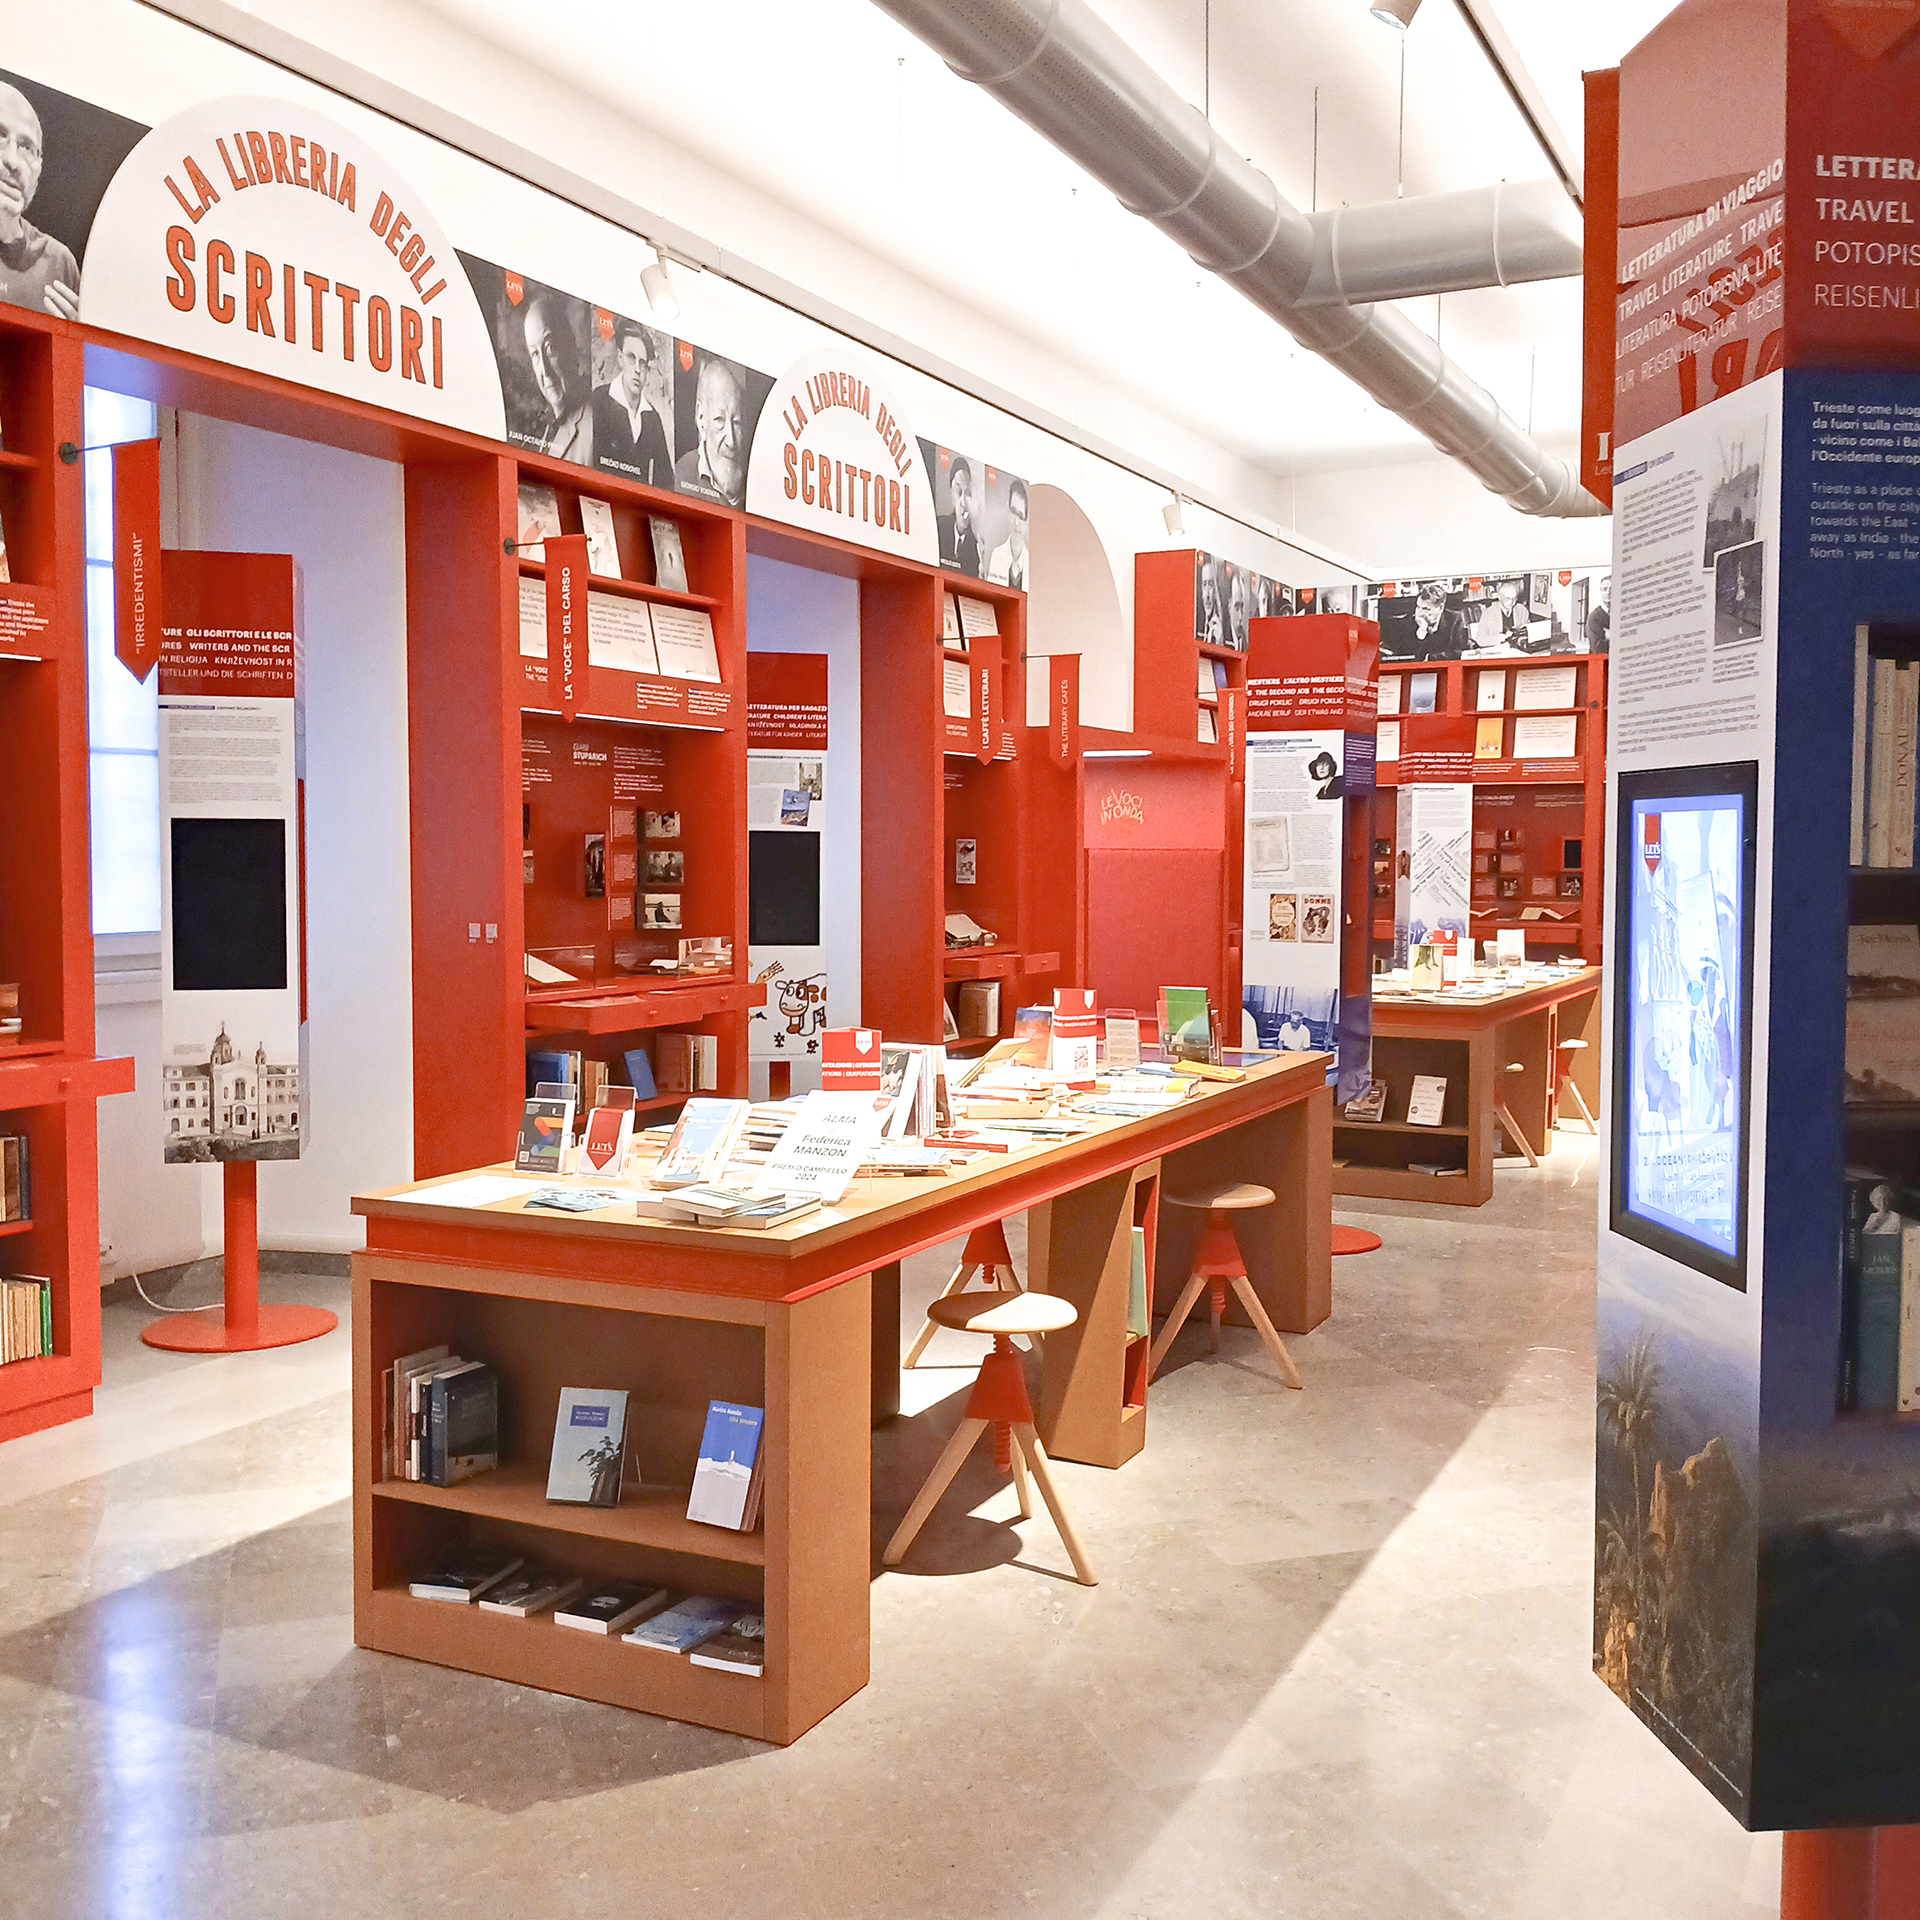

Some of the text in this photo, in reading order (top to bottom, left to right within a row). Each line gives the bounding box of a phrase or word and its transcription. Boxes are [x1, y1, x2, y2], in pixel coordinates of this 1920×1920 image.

[1815, 198, 1914, 223] TRAVEL
[164, 131, 446, 304] LA LIBRERIA DEGLI
[1622, 158, 1783, 284] LETTERATURA DI VIAGGIO
[1619, 199, 1783, 321] TRAVEL LITERATURE TRAVE
[166, 225, 443, 389] SCRITTORI
[1616, 308, 1678, 360] LITERATURA
[1682, 264, 1749, 322] POTOPISNA
[1813, 402, 1855, 414] Trieste
[1858, 405, 1892, 414] come
[783, 372, 912, 477] LA LIBRERIA DEGLI
[1812, 418, 1827, 429] da
[1831, 418, 1859, 430] fuori
[1862, 420, 1890, 431] sulla
[1820, 435, 1857, 446] vicino
[1860, 438, 1894, 447] come
[784, 443, 909, 535] SCRITTORI
[1812, 483, 1913, 496] Trieste as a place
[1811, 500, 1855, 510] outside
[1858, 502, 1873, 510] on
[1877, 500, 1896, 511] the
[1811, 516, 1908, 527] towards the East
[1810, 533, 1840, 544] away
[1844, 533, 1857, 543] as
[1860, 532, 1889, 543] India
[1810, 548, 1843, 558] North
[1855, 550, 1874, 560] yes
[1887, 550, 1900, 559] as
[562, 567, 571, 610] CARSO
[562, 611, 571, 634] DEL
[204, 630, 253, 638] SCRITTORI
[231, 644, 251, 652] AND
[276, 658, 285, 666] IN
[201, 669, 219, 677] UND
[221, 670, 234, 678] DIE
[564, 684, 572, 699] LA
[981, 717, 989, 744] CAFFÈ
[573, 752, 607, 761] STUPARICH
[1102, 788, 1143, 810] LE VOCI
[1101, 806, 1144, 825] IN ONDA
[822, 1114, 857, 1124] ALMA
[802, 1135, 850, 1146] Federica
[793, 1146, 847, 1157] MANZON
[772, 1163, 847, 1174] PREMIO CAMPIELLO
